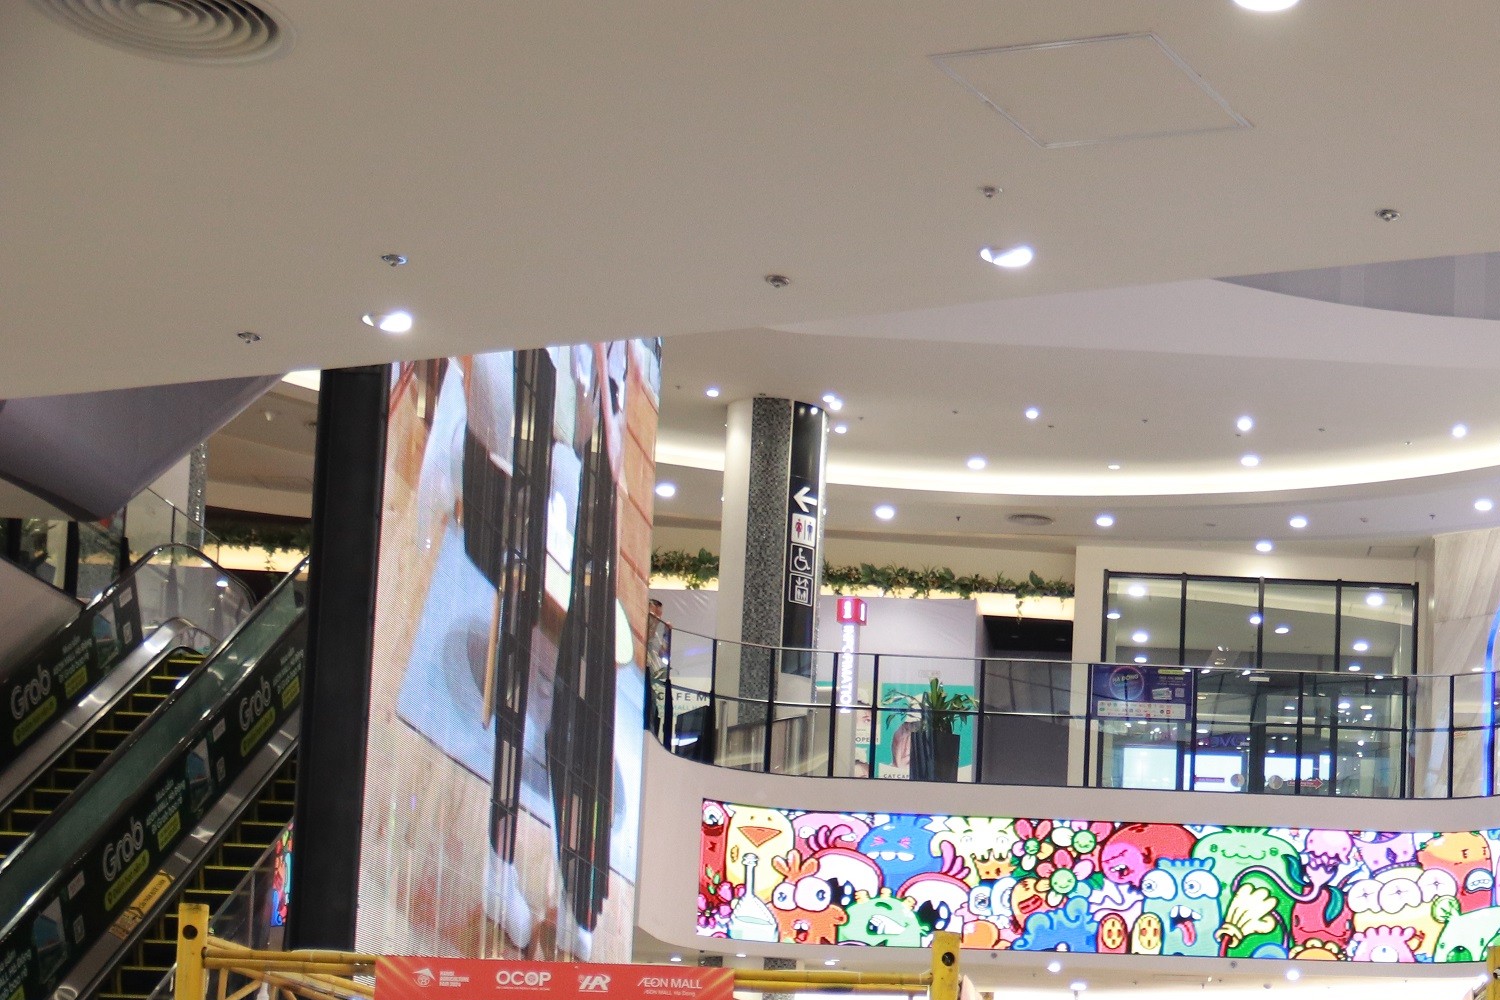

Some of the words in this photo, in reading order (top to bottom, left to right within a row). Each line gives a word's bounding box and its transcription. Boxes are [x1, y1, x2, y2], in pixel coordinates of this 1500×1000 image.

[10, 664, 51, 720] Grab
[103, 817, 144, 881] Grab
[495, 970, 551, 987] OCOP
[670, 978, 702, 989] MALL
